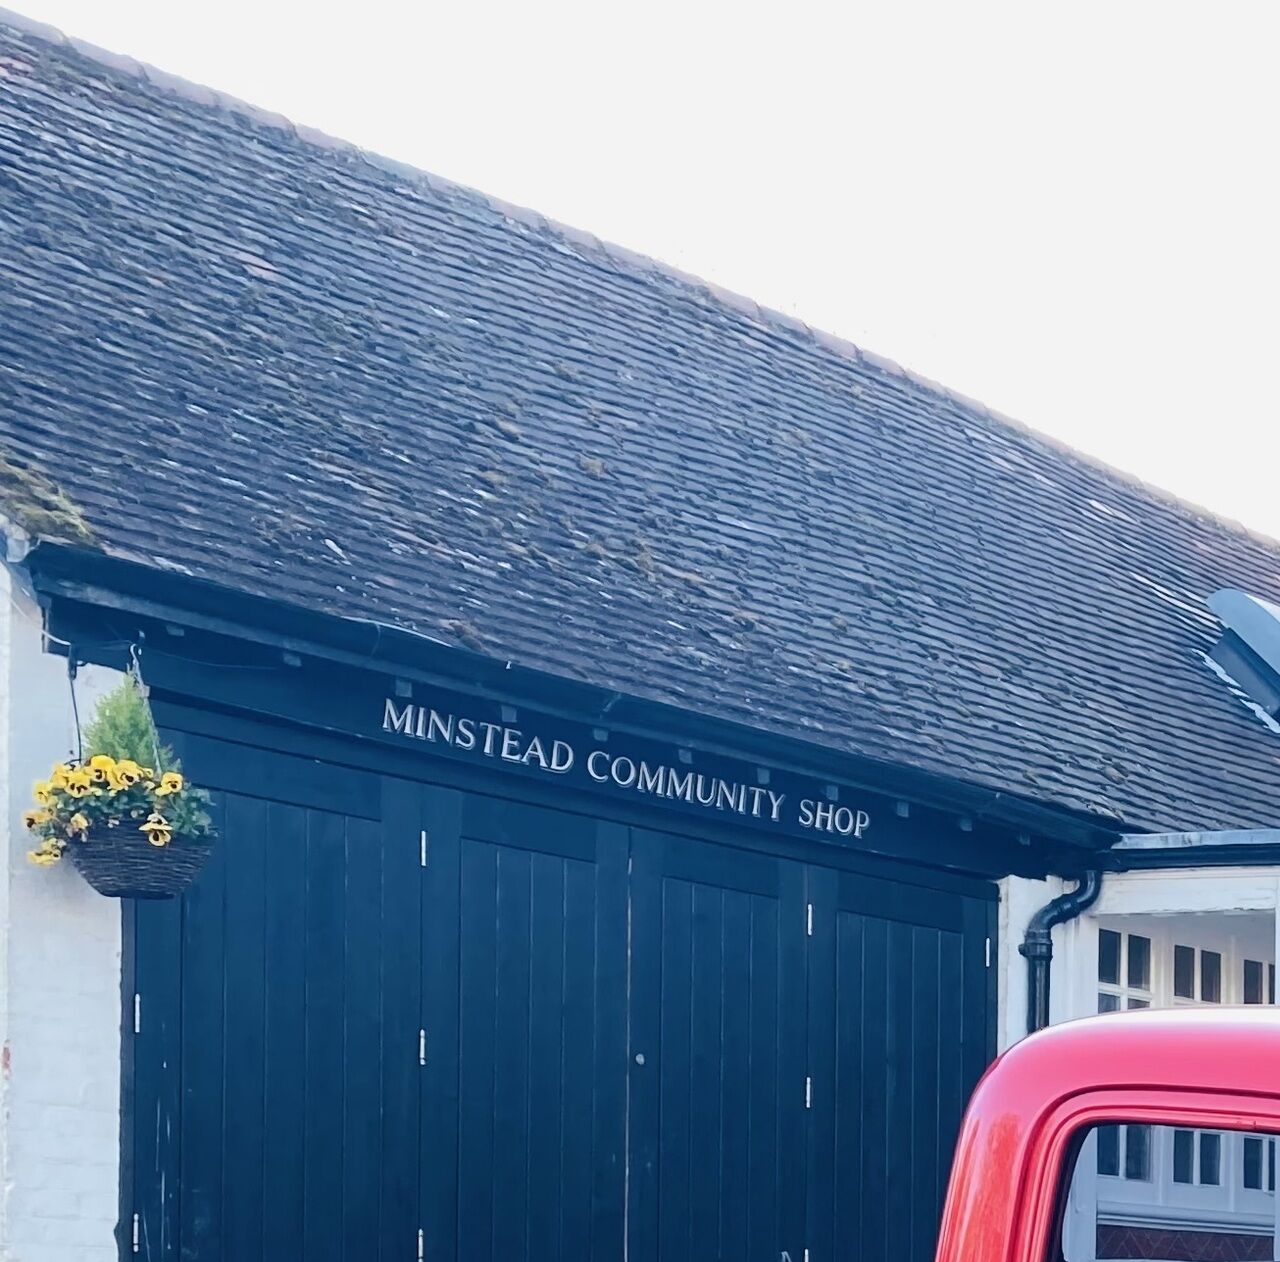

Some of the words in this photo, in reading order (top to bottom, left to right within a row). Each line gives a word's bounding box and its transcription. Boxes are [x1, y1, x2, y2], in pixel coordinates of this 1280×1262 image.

[381, 697, 575, 775] MINSTEAD
[587, 750, 786, 822] COMMUNITY
[798, 799, 871, 840] SHOP
